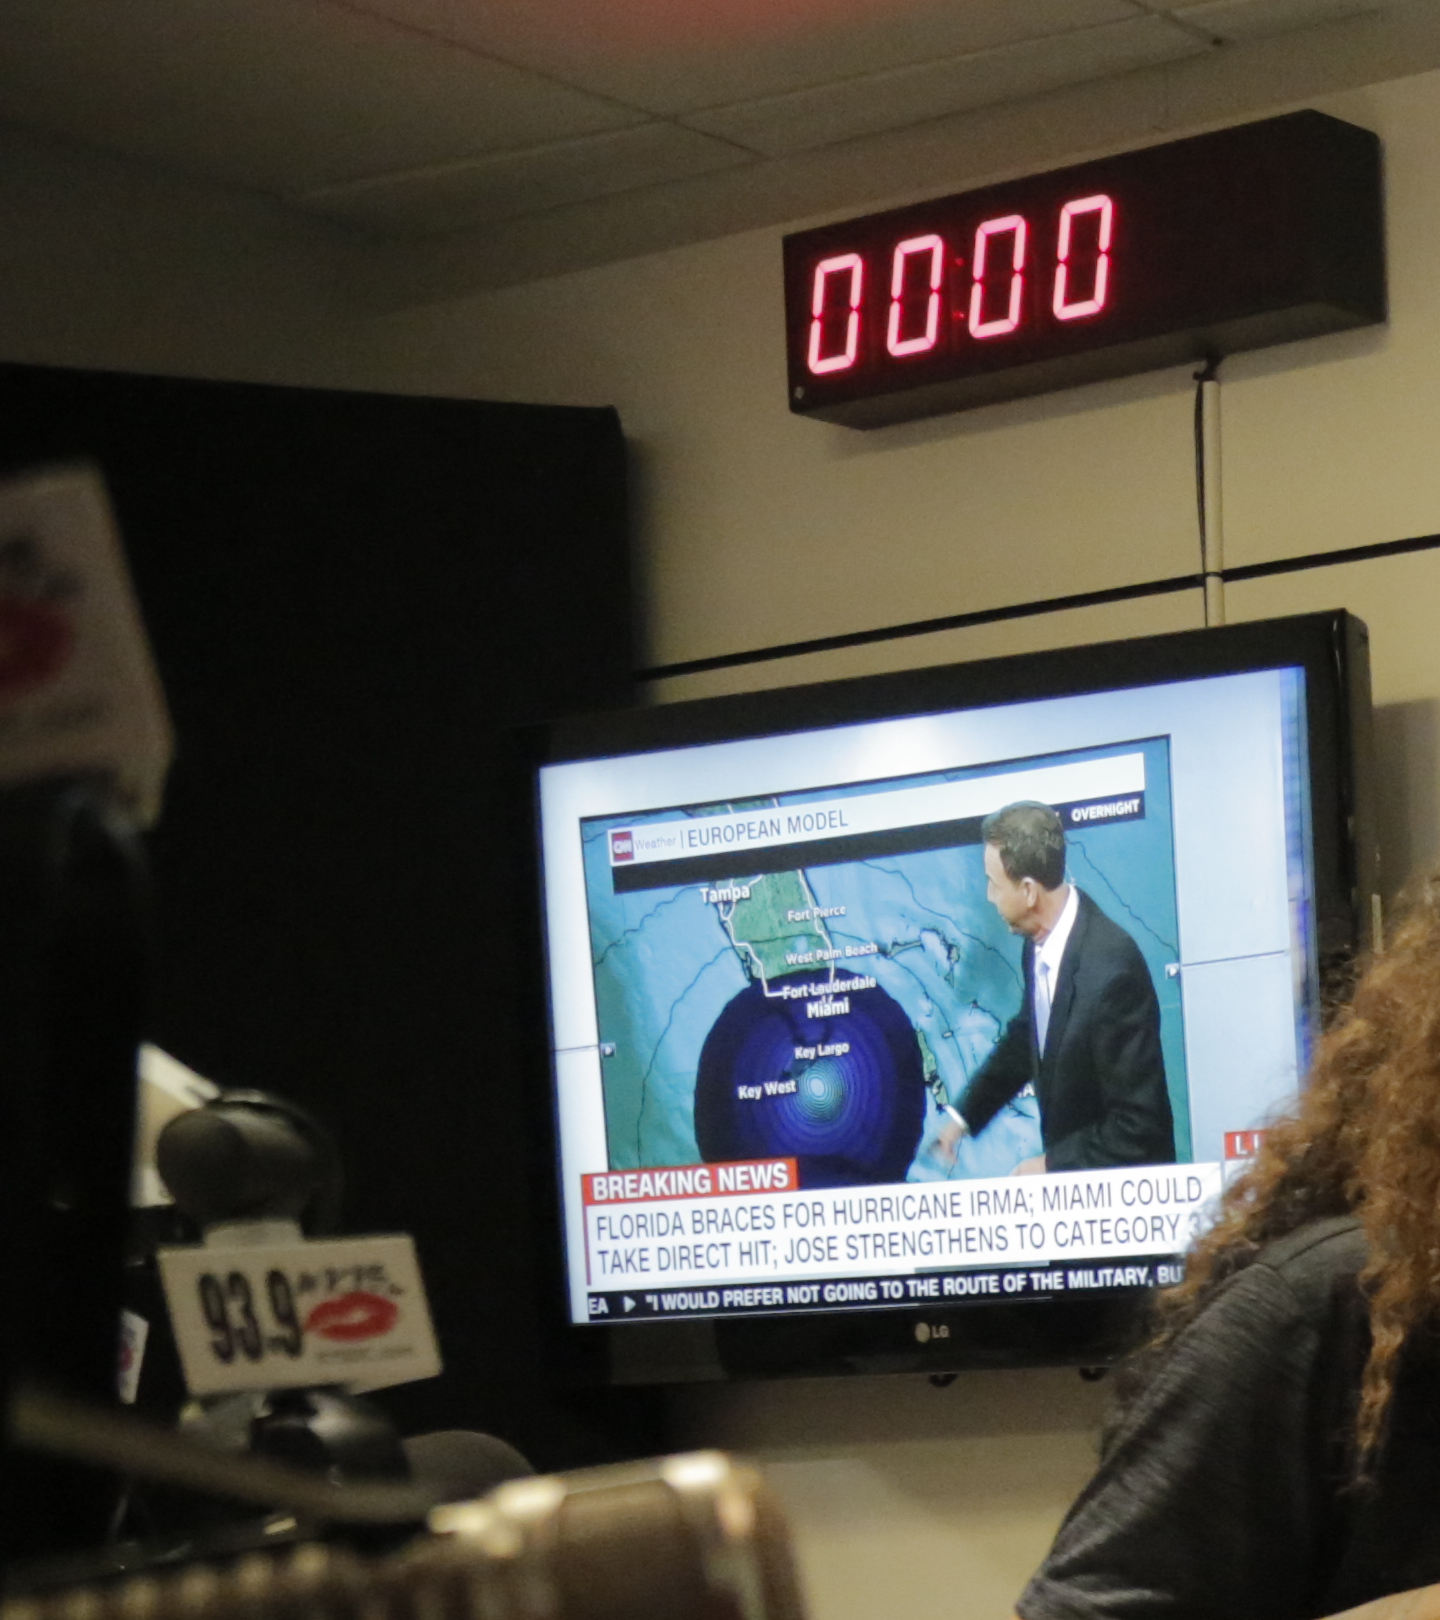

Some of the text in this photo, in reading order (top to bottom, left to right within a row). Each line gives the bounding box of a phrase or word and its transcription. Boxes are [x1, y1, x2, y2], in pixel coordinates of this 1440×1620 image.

[1071, 798, 1141, 822] OVERNIGHT
[634, 835, 678, 851] Weather
[687, 817, 782, 848] EUROPEAN
[787, 809, 849, 834] MODEL
[700, 885, 751, 904] Tampa
[787, 905, 847, 922] Fort Pierce
[786, 942, 879, 965] West Palm Beach
[782, 975, 877, 999] Fort Lauderdale
[806, 996, 850, 1018] Miami
[795, 1042, 850, 1060] Key Largo
[738, 1079, 797, 1100] Key West
[592, 1162, 790, 1202] BREAKING NEWS
[597, 1175, 1203, 1241] FLORIDA BRACES FOR HURRICANE IRMA; MIAMI COULD
[597, 1246, 651, 1275] TAKE
[658, 1242, 732, 1271] DIRECT
[739, 1240, 778, 1270] HIT;
[785, 1235, 839, 1265] JOSE
[846, 1224, 1010, 1260] STRENGTHENS
[1016, 1222, 1046, 1250] TO
[1053, 1213, 1182, 1247] CATEGORY
[588, 1298, 610, 1316] EA
[661, 1290, 720, 1312] WOULD
[723, 1286, 784, 1308] PREFER
[787, 1284, 820, 1305] NOT
[823, 1281, 878, 1303] GOING
[880, 1279, 904, 1299] TO
[907, 1278, 940, 1298] THE
[943, 1275, 1000, 1296] ROUTE
[1003, 1273, 1027, 1293] OF
[1030, 1271, 1064, 1291] THE
[1067, 1266, 1153, 1289] MILITARY,
[1157, 1264, 1184, 1285] BU
[199, 1268, 303, 1362] 93.9
[931, 1326, 949, 1339] LG
